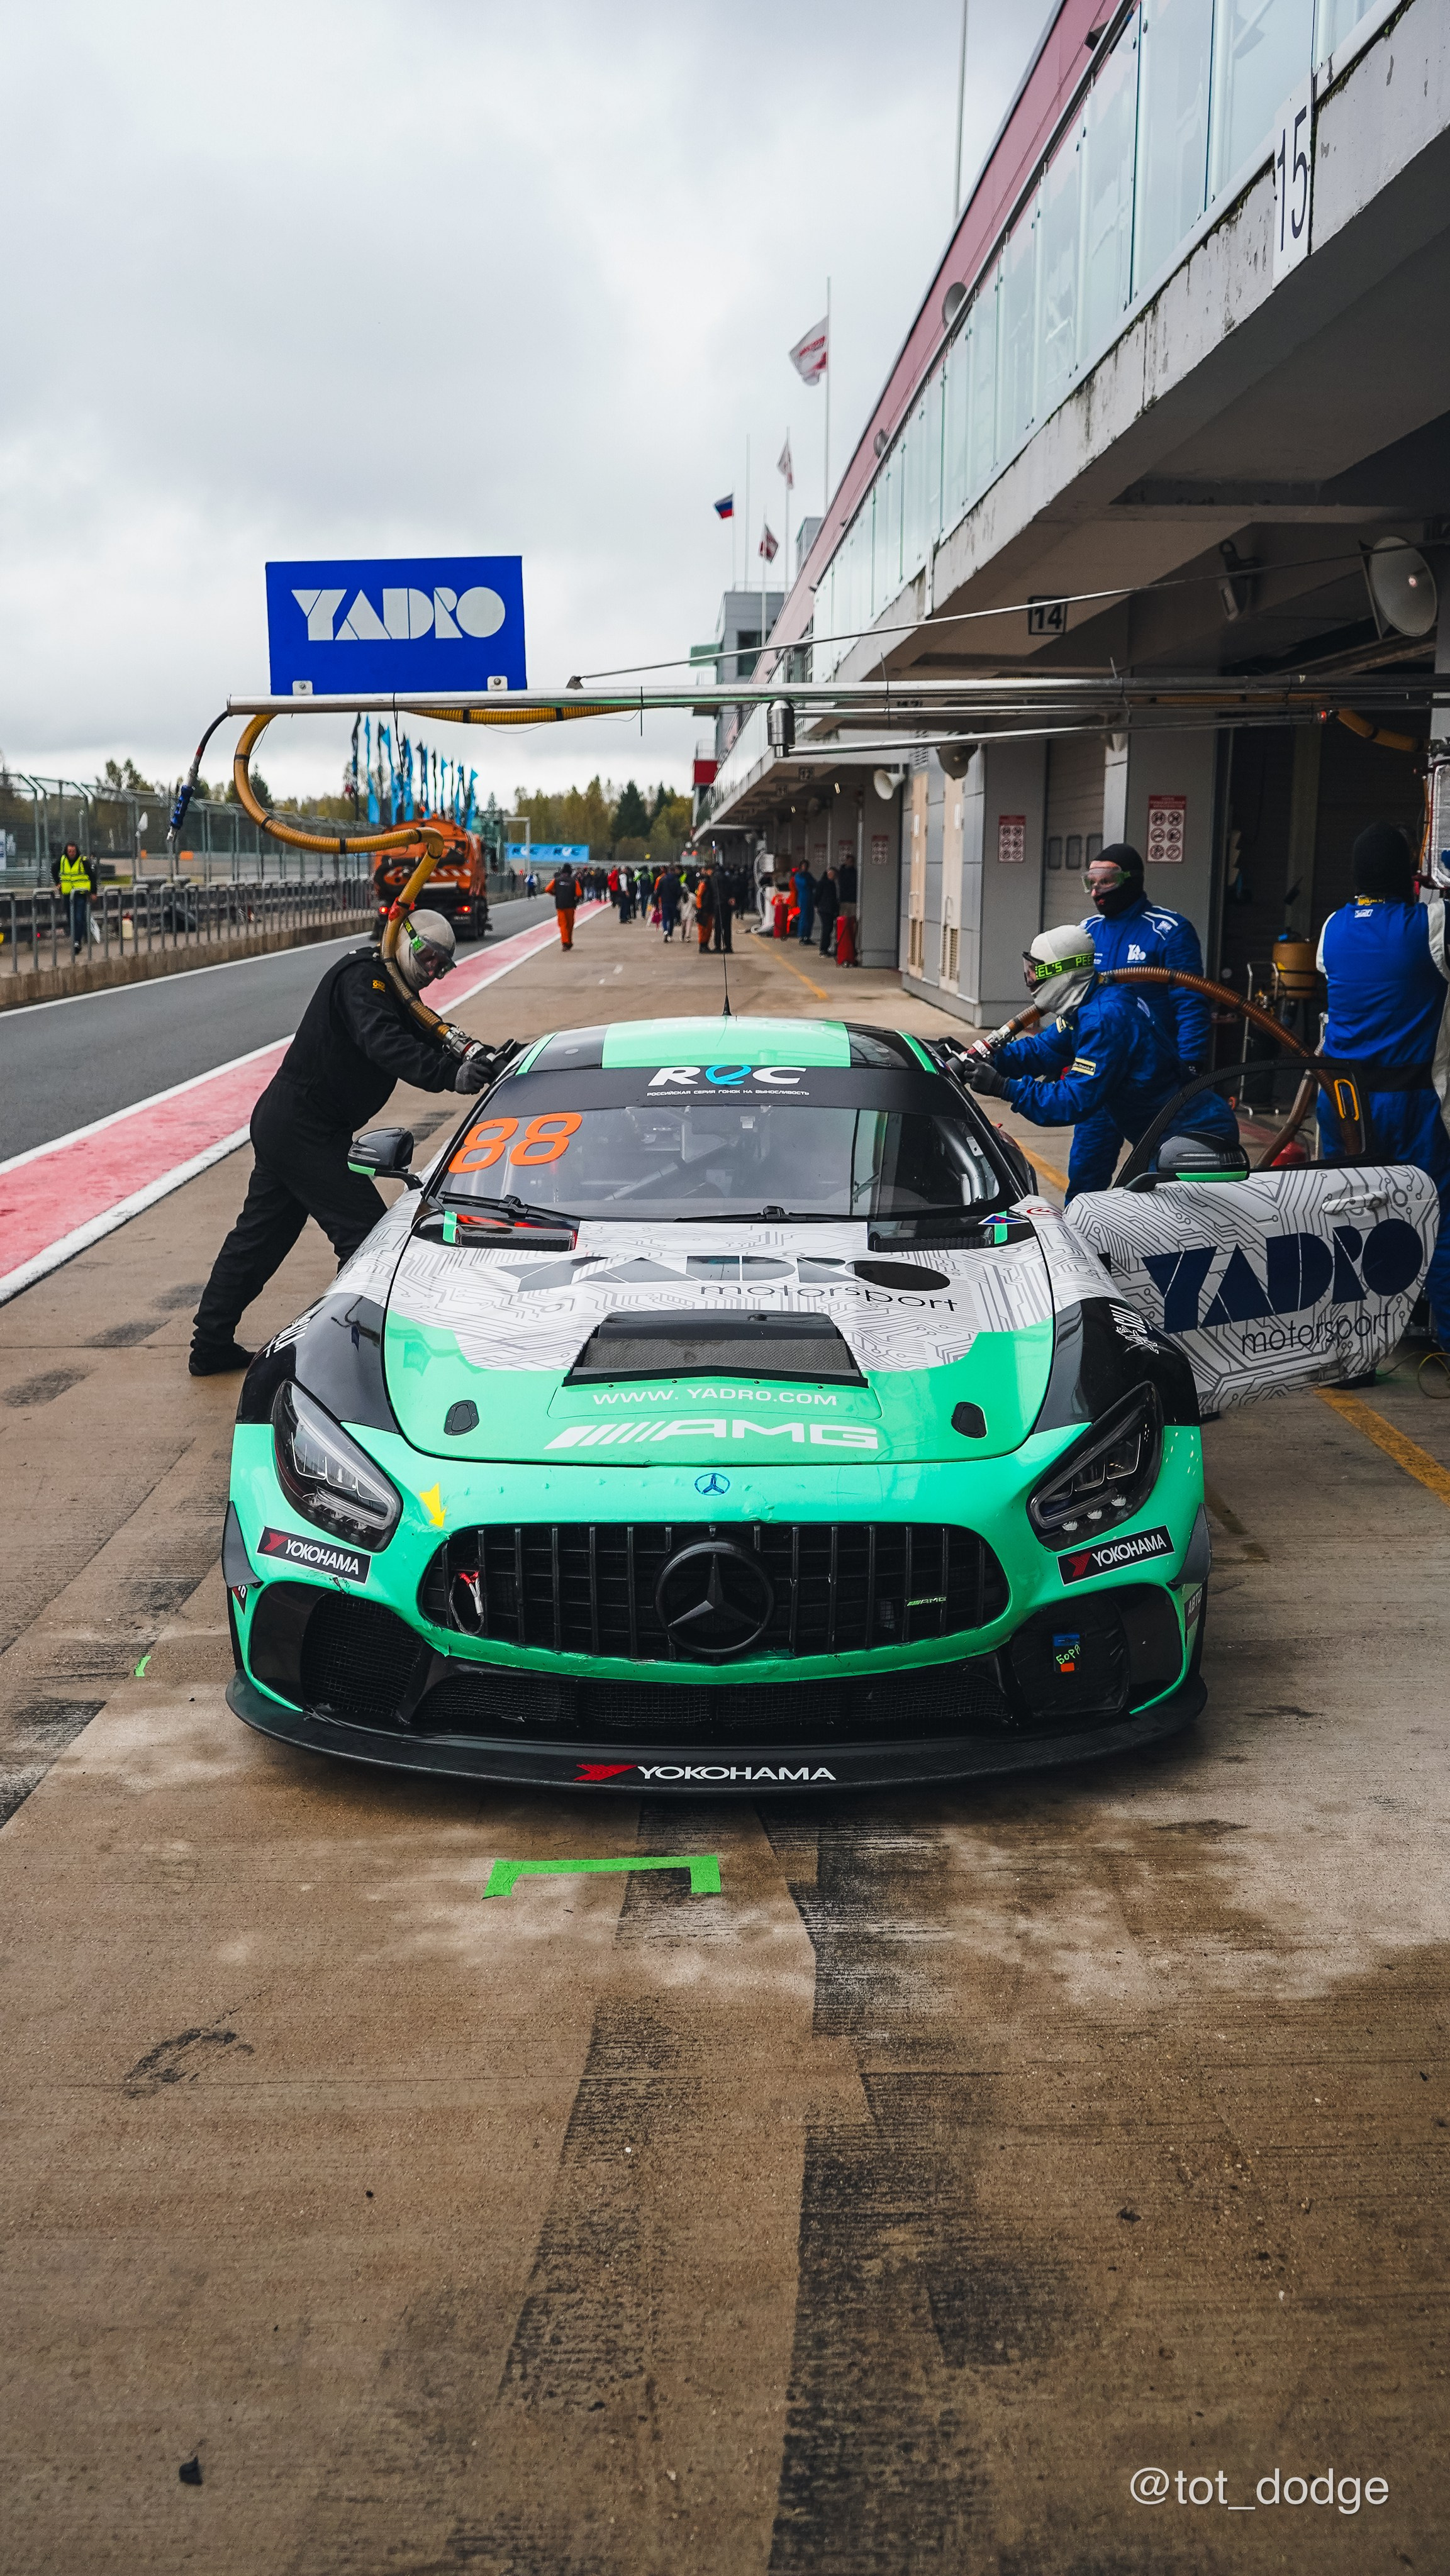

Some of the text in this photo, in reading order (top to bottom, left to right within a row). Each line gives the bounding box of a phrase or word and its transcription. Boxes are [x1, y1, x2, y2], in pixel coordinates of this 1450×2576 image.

[1277, 105, 1307, 252] 15
[291, 587, 505, 641] YADRO
[1034, 604, 1062, 629] 14
[448, 1113, 583, 1174] 88
[496, 1255, 951, 1292] YADRO
[1141, 1219, 1424, 1335] YADRO
[701, 1284, 958, 1312] motorsport
[1241, 1312, 1391, 1356] motorsport
[687, 1388, 837, 1406] YADRO.COM
[285, 1539, 359, 1575] YOKOHAMA
[1091, 1534, 1167, 1567] YOKOHAMA
[637, 1766, 837, 1780] YOKOHAMA
